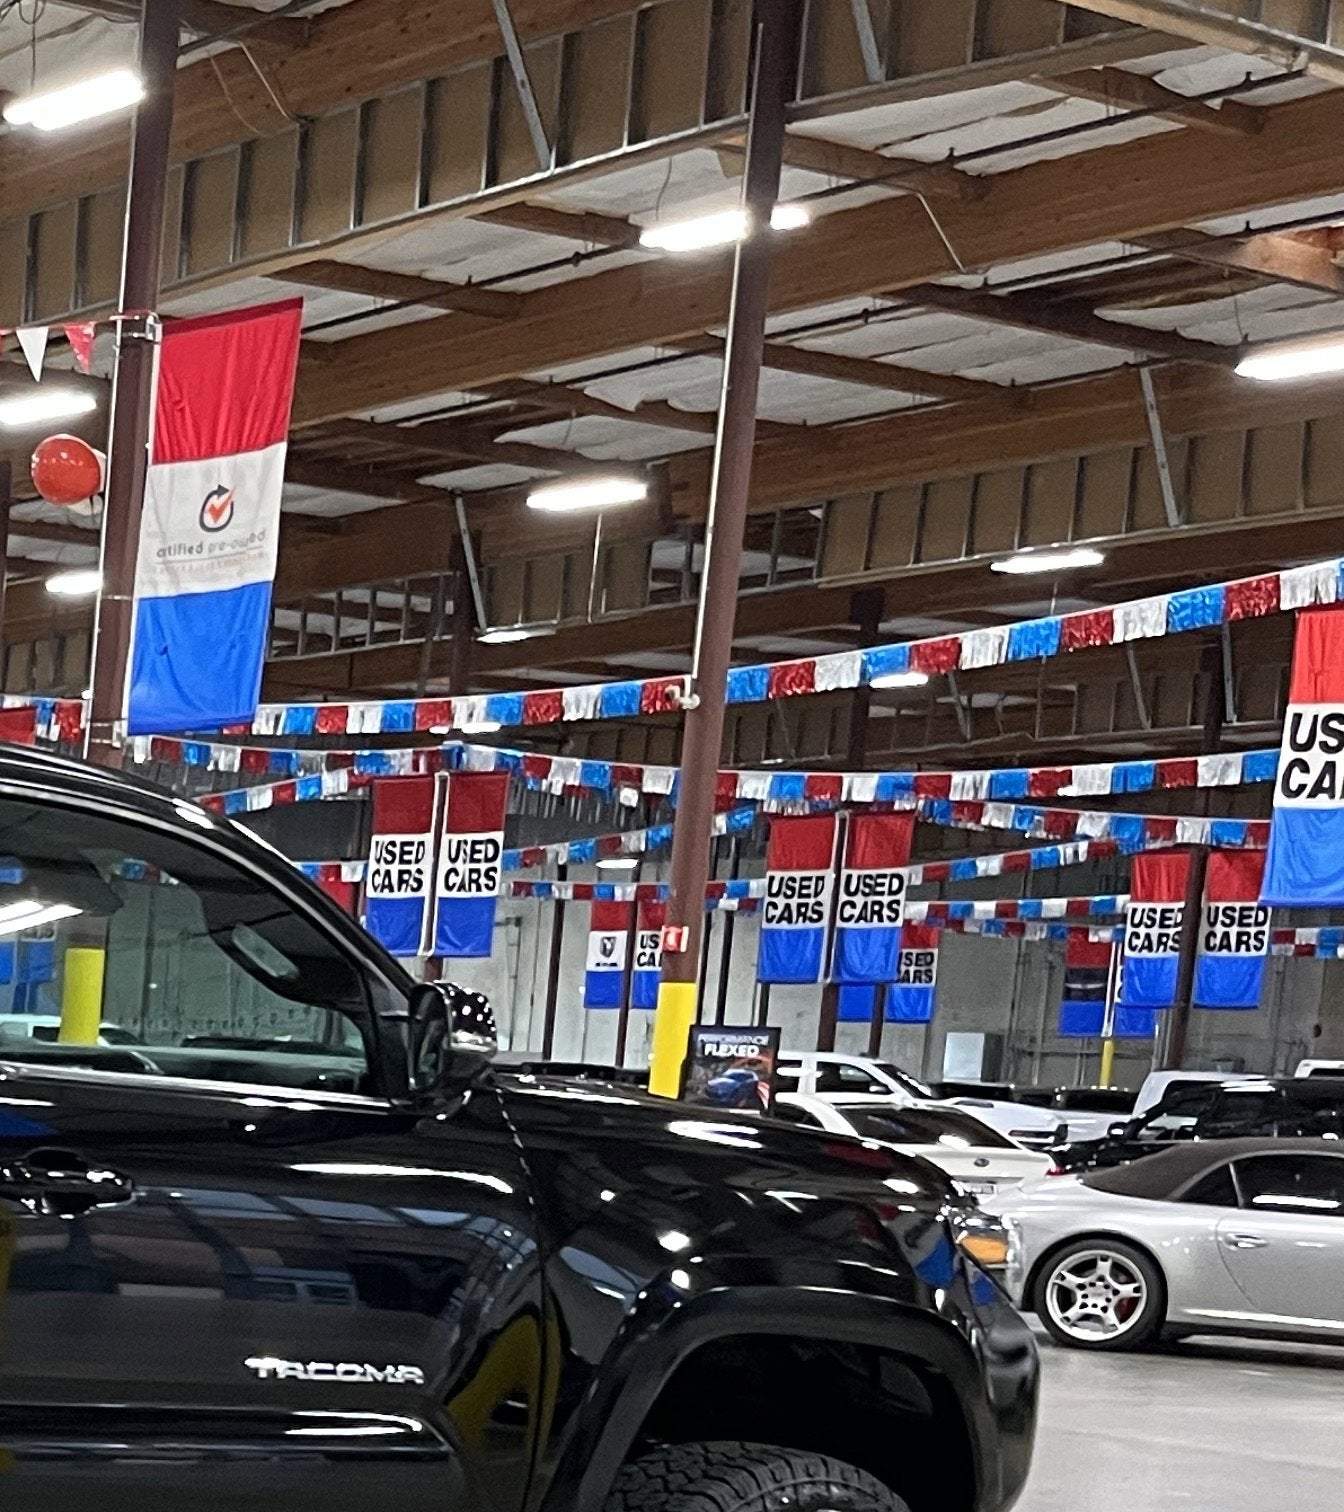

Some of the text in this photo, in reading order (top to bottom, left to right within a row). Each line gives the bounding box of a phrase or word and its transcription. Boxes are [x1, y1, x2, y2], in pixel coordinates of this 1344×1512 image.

[1290, 712, 1344, 754] US
[1281, 757, 1344, 799] CA
[374, 840, 425, 865] USED
[447, 838, 500, 864] USED
[372, 868, 424, 893] CARS
[444, 866, 498, 892] CARS
[767, 875, 825, 899] USED
[844, 873, 904, 897] USED
[765, 901, 823, 924] CARS
[839, 900, 900, 923] CARS
[1130, 907, 1184, 929] USED
[1207, 906, 1268, 928] USED
[640, 933, 660, 949] US
[1128, 931, 1180, 953] CARS
[1205, 930, 1265, 953] CARS
[637, 951, 662, 967] CA
[897, 968, 933, 984] ARS
[704, 1043, 760, 1057] FLEXED
[244, 1356, 425, 1384] TACOMA
